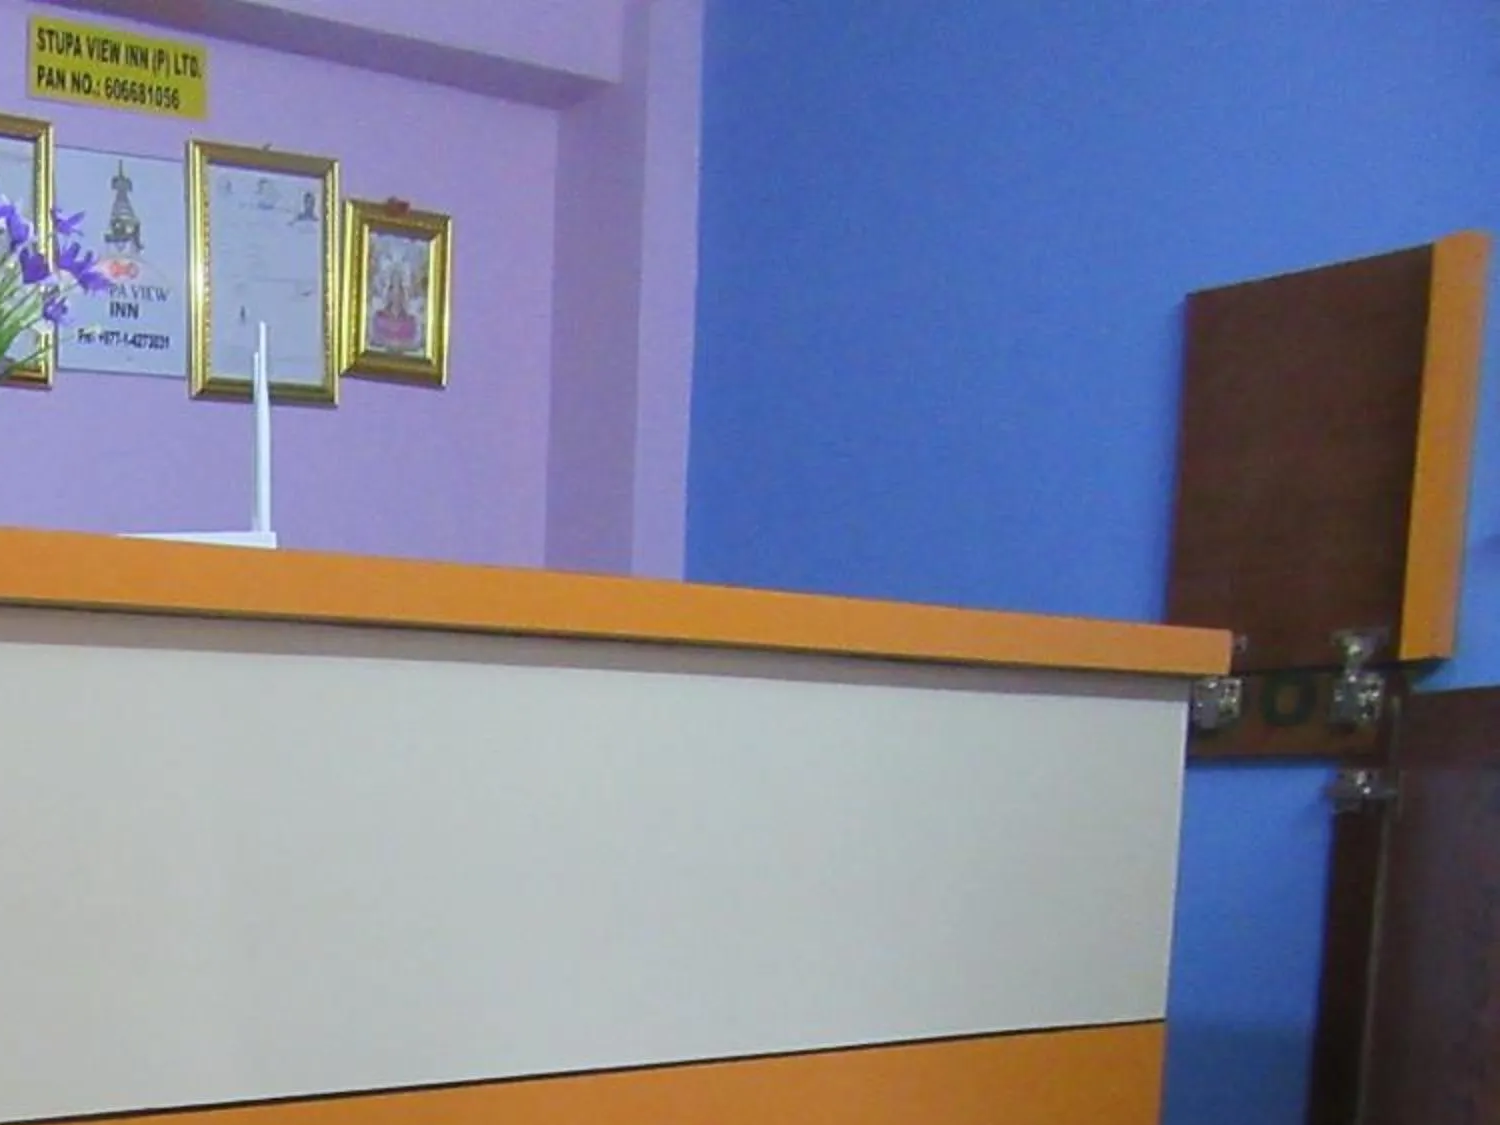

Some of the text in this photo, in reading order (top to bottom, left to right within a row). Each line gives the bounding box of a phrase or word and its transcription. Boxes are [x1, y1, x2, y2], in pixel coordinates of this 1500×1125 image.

[36, 26, 202, 80] STUPA VIEW INN (P) LTD.
[36, 64, 67, 89] PAN
[131, 284, 170, 302] VIEW
[109, 301, 139, 320] INN
